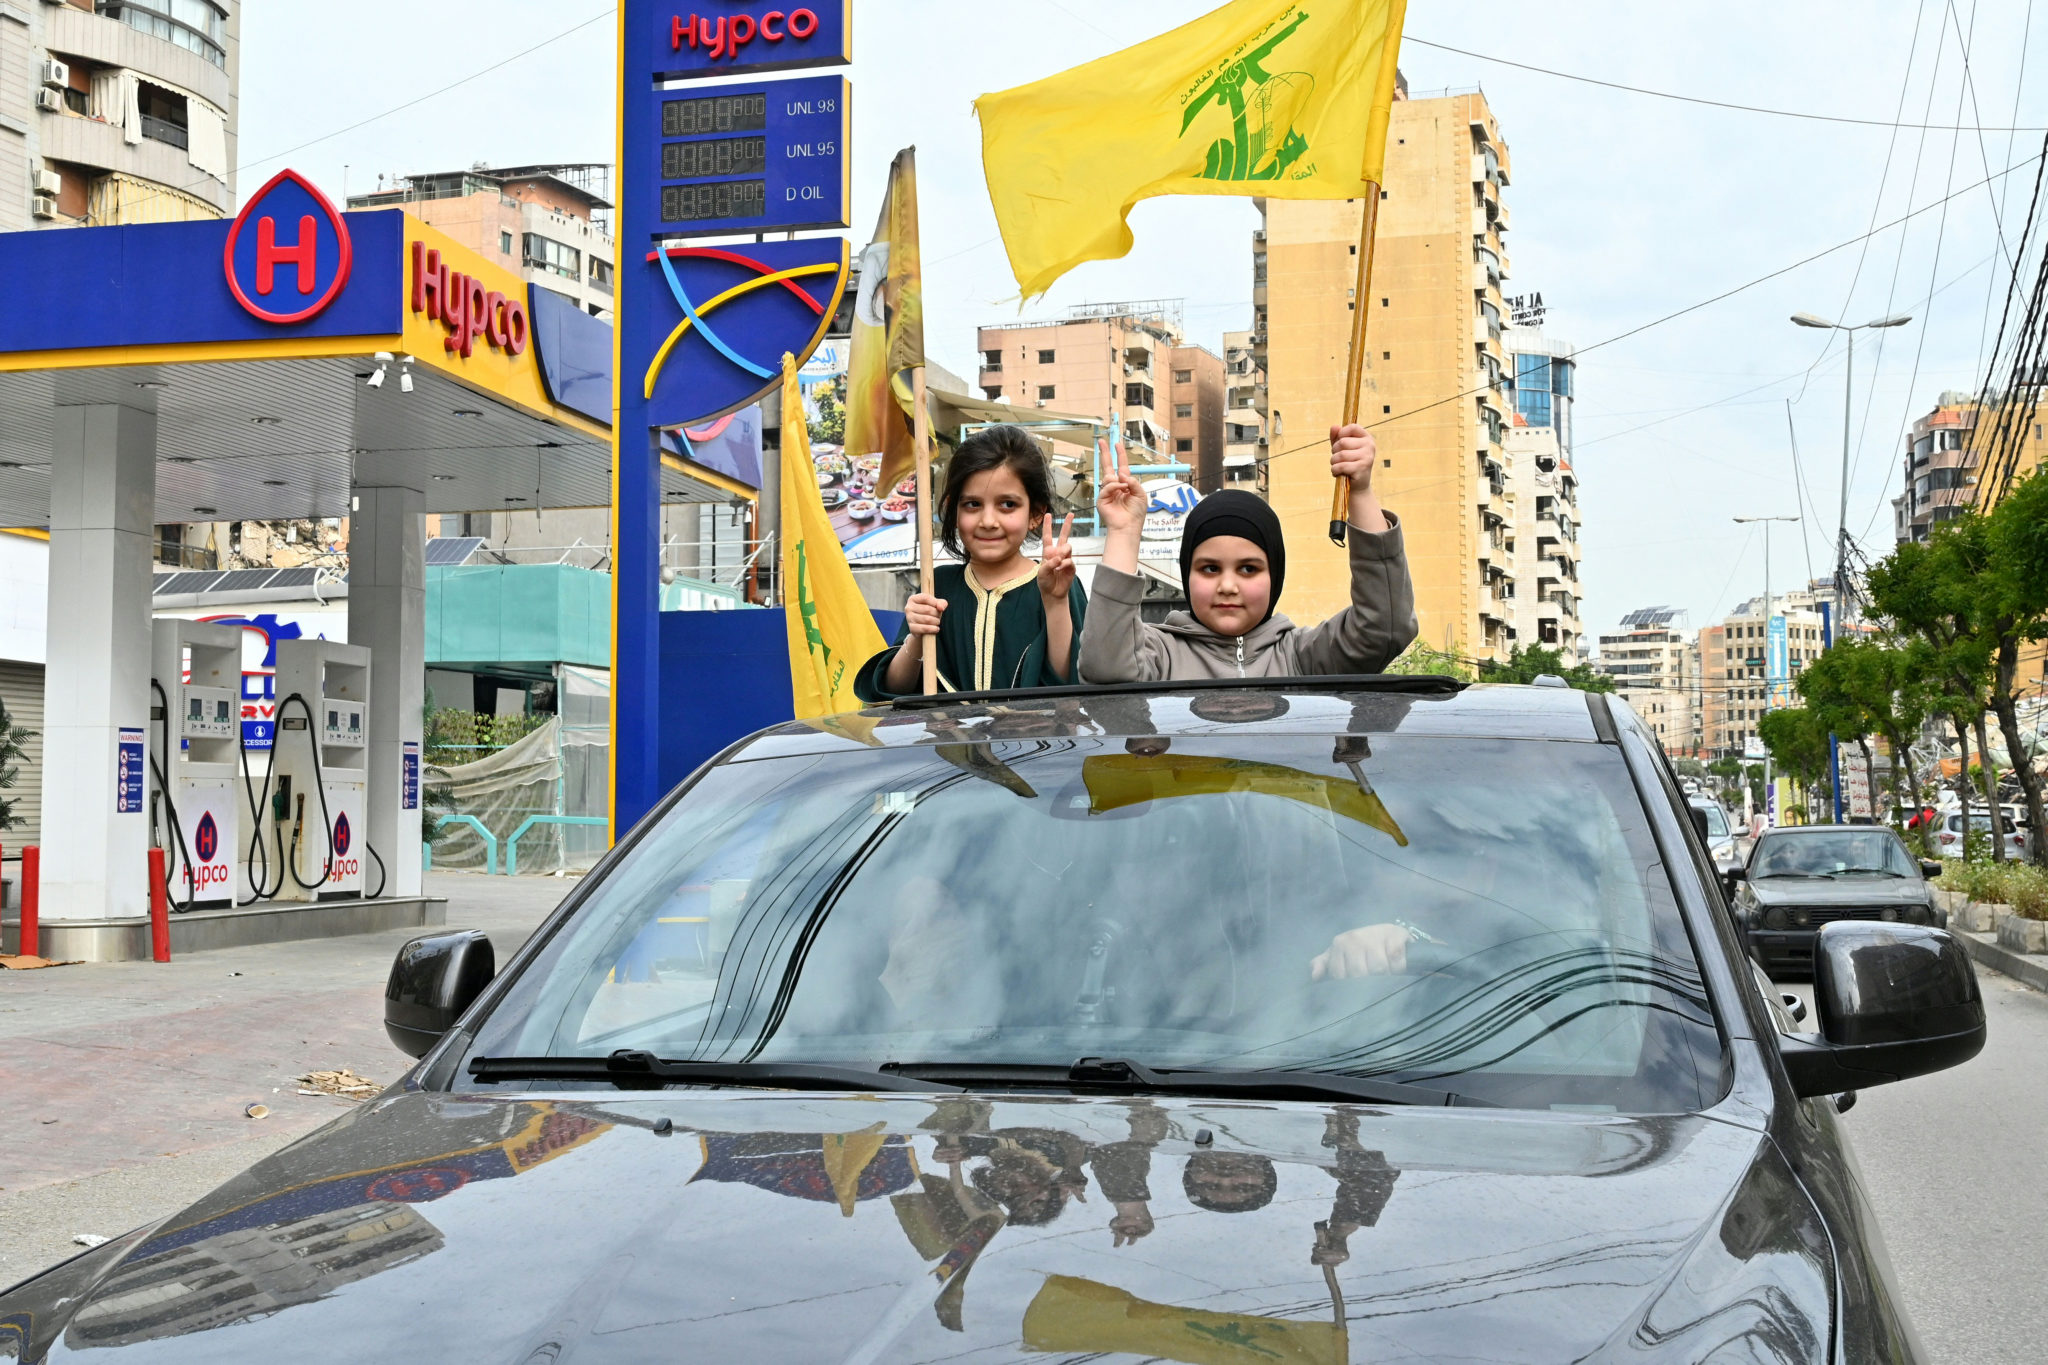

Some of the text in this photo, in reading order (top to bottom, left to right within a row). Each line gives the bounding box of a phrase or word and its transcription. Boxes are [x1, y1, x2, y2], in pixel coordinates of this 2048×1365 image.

[671, 8, 819, 60] Hypco
[786, 98, 835, 116] UNL 98
[786, 141, 835, 158] UNL 95
[786, 185, 824, 201] D OIL
[255, 214, 317, 296] H
[411, 240, 527, 358] Hypco
[1147, 518, 1180, 526] The Sailor
